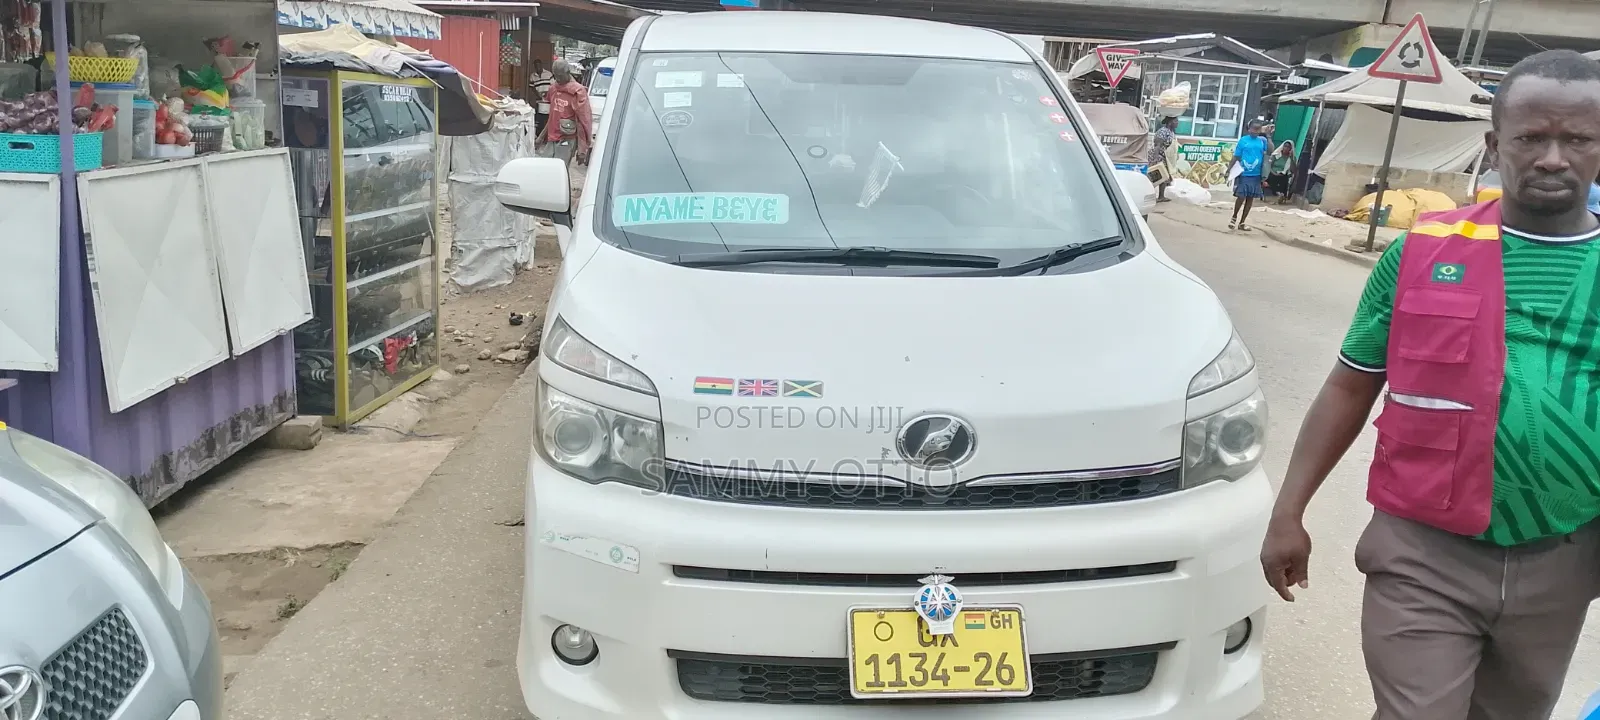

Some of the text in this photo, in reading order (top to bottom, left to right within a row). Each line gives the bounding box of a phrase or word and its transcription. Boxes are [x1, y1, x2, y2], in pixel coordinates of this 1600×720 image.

[1106, 54, 1127, 62] GIV
[1108, 62, 1125, 70] WAY
[1187, 152, 1215, 161] KITCHEN
[624, 197, 704, 222] NYAME
[990, 613, 1013, 629] GH
[864, 651, 1015, 688] 1134-26
